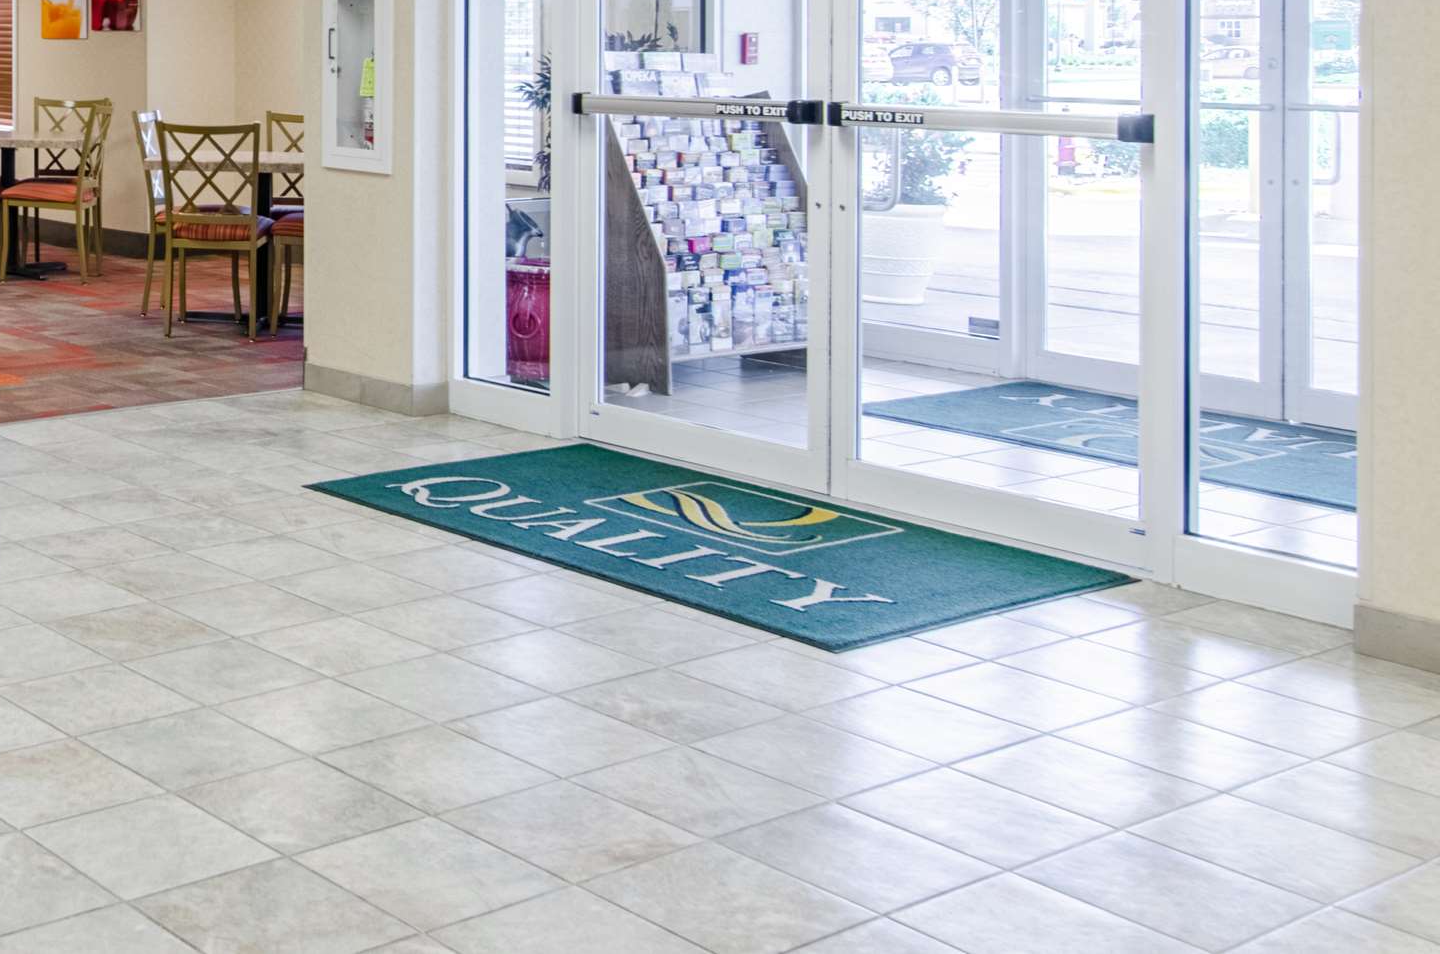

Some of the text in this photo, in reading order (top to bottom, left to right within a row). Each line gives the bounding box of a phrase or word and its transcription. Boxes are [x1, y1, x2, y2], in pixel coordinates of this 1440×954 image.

[716, 104, 787, 117] PUSH TO EXIT
[842, 110, 923, 123] PUSH TO EXIT
[384, 476, 896, 612] QUALITY
